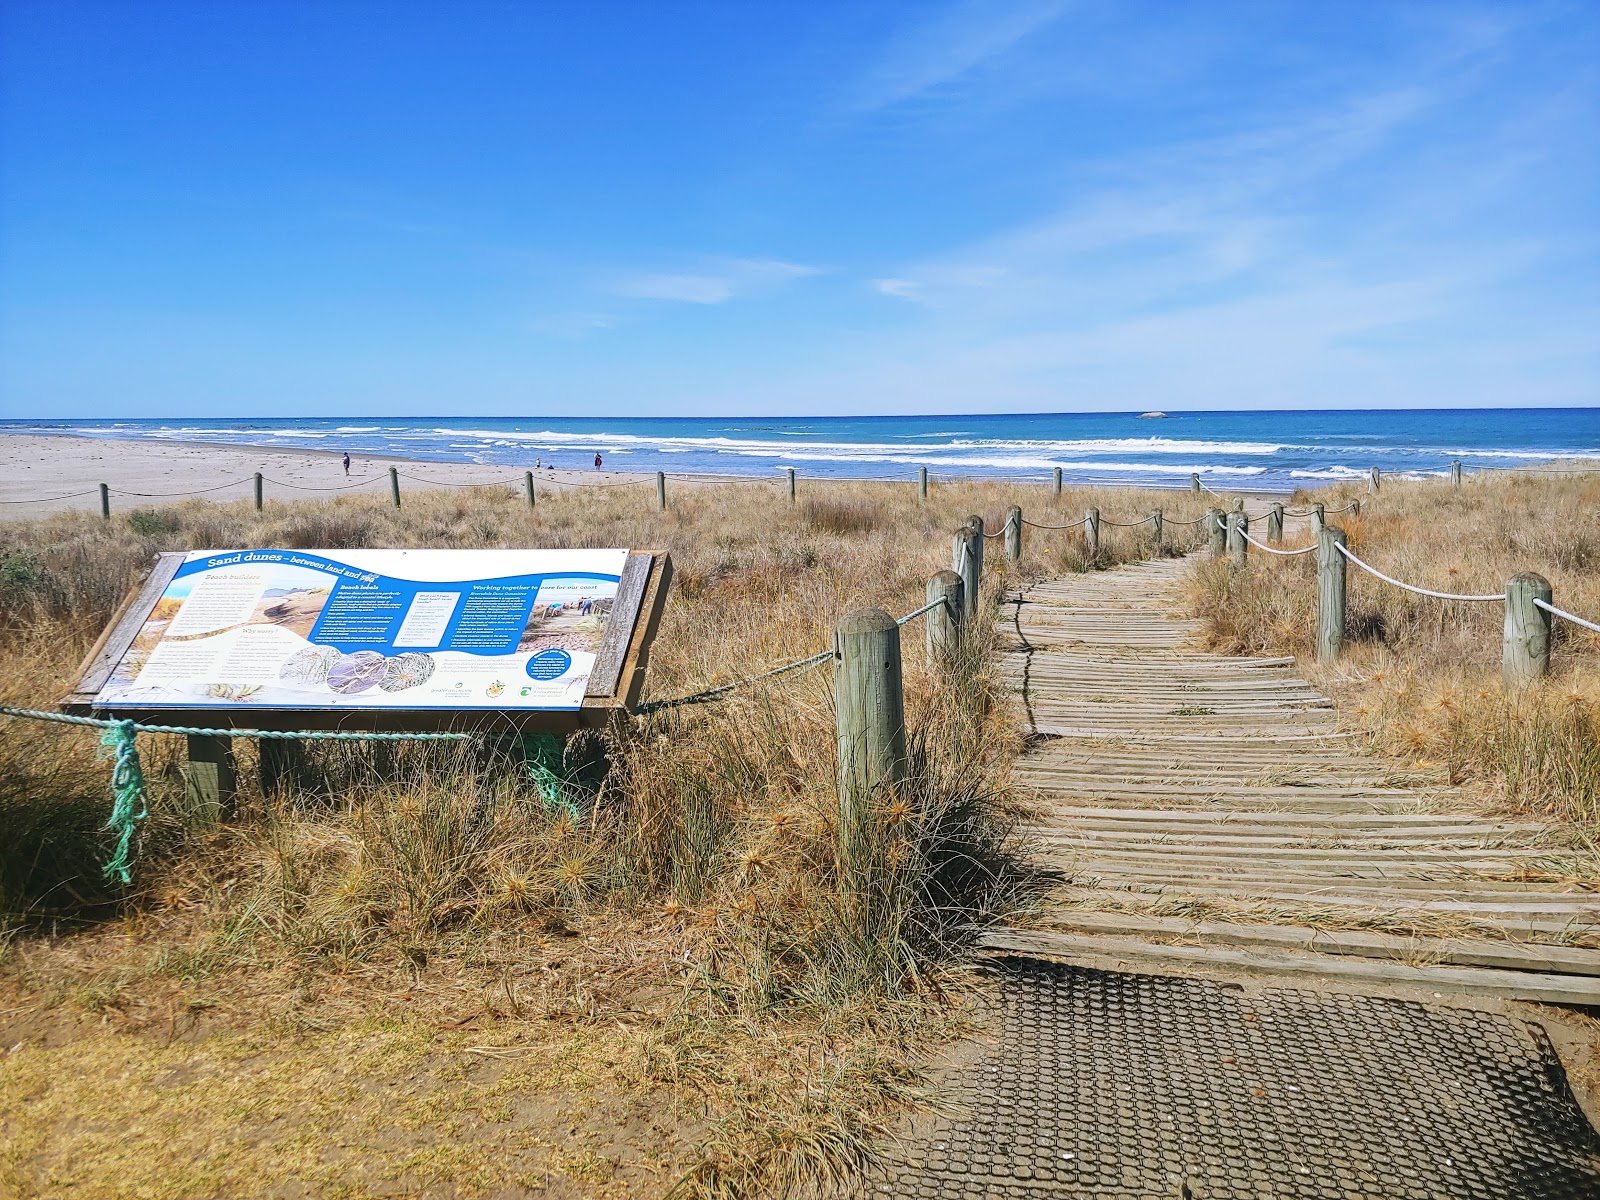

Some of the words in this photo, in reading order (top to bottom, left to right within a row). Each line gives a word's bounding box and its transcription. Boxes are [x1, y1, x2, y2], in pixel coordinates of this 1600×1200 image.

[207, 553, 241, 567] Sand
[243, 552, 283, 562] dunes
[290, 556, 325, 569] between
[325, 563, 346, 575] land
[343, 571, 362, 579] and
